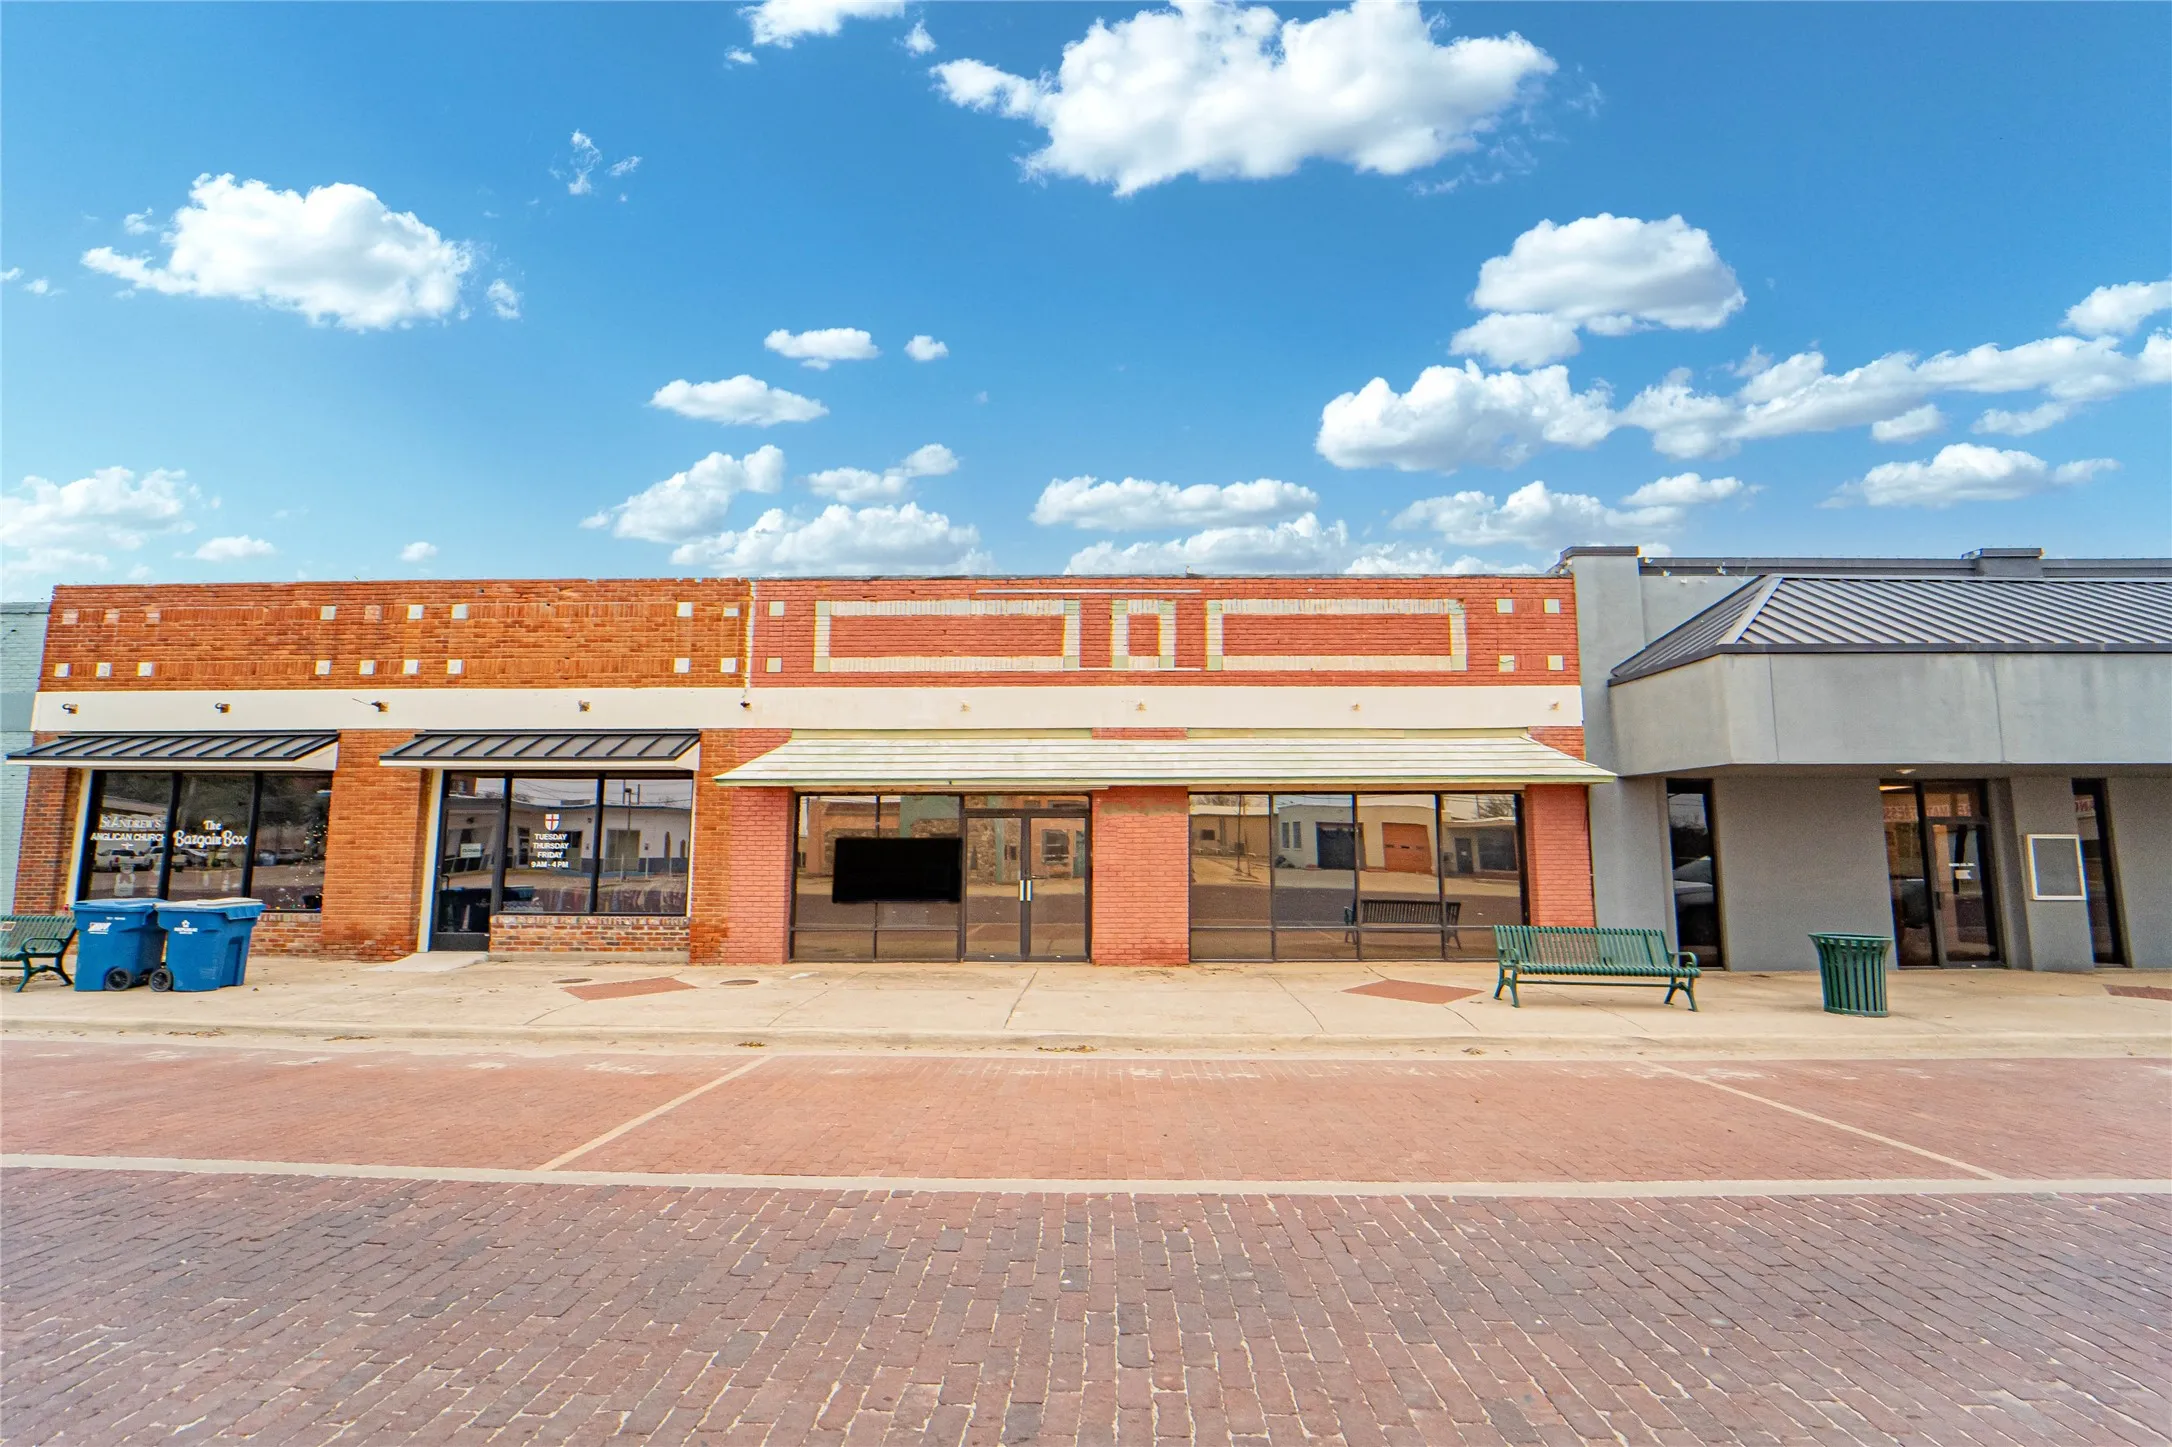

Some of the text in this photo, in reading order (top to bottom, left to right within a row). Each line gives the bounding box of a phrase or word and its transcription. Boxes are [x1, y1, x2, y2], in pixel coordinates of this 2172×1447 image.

[203, 820, 222, 830] The
[90, 832, 132, 841] ANGLICAN
[222, 830, 248, 847] Box
[537, 851, 563, 859] FRIDAY
